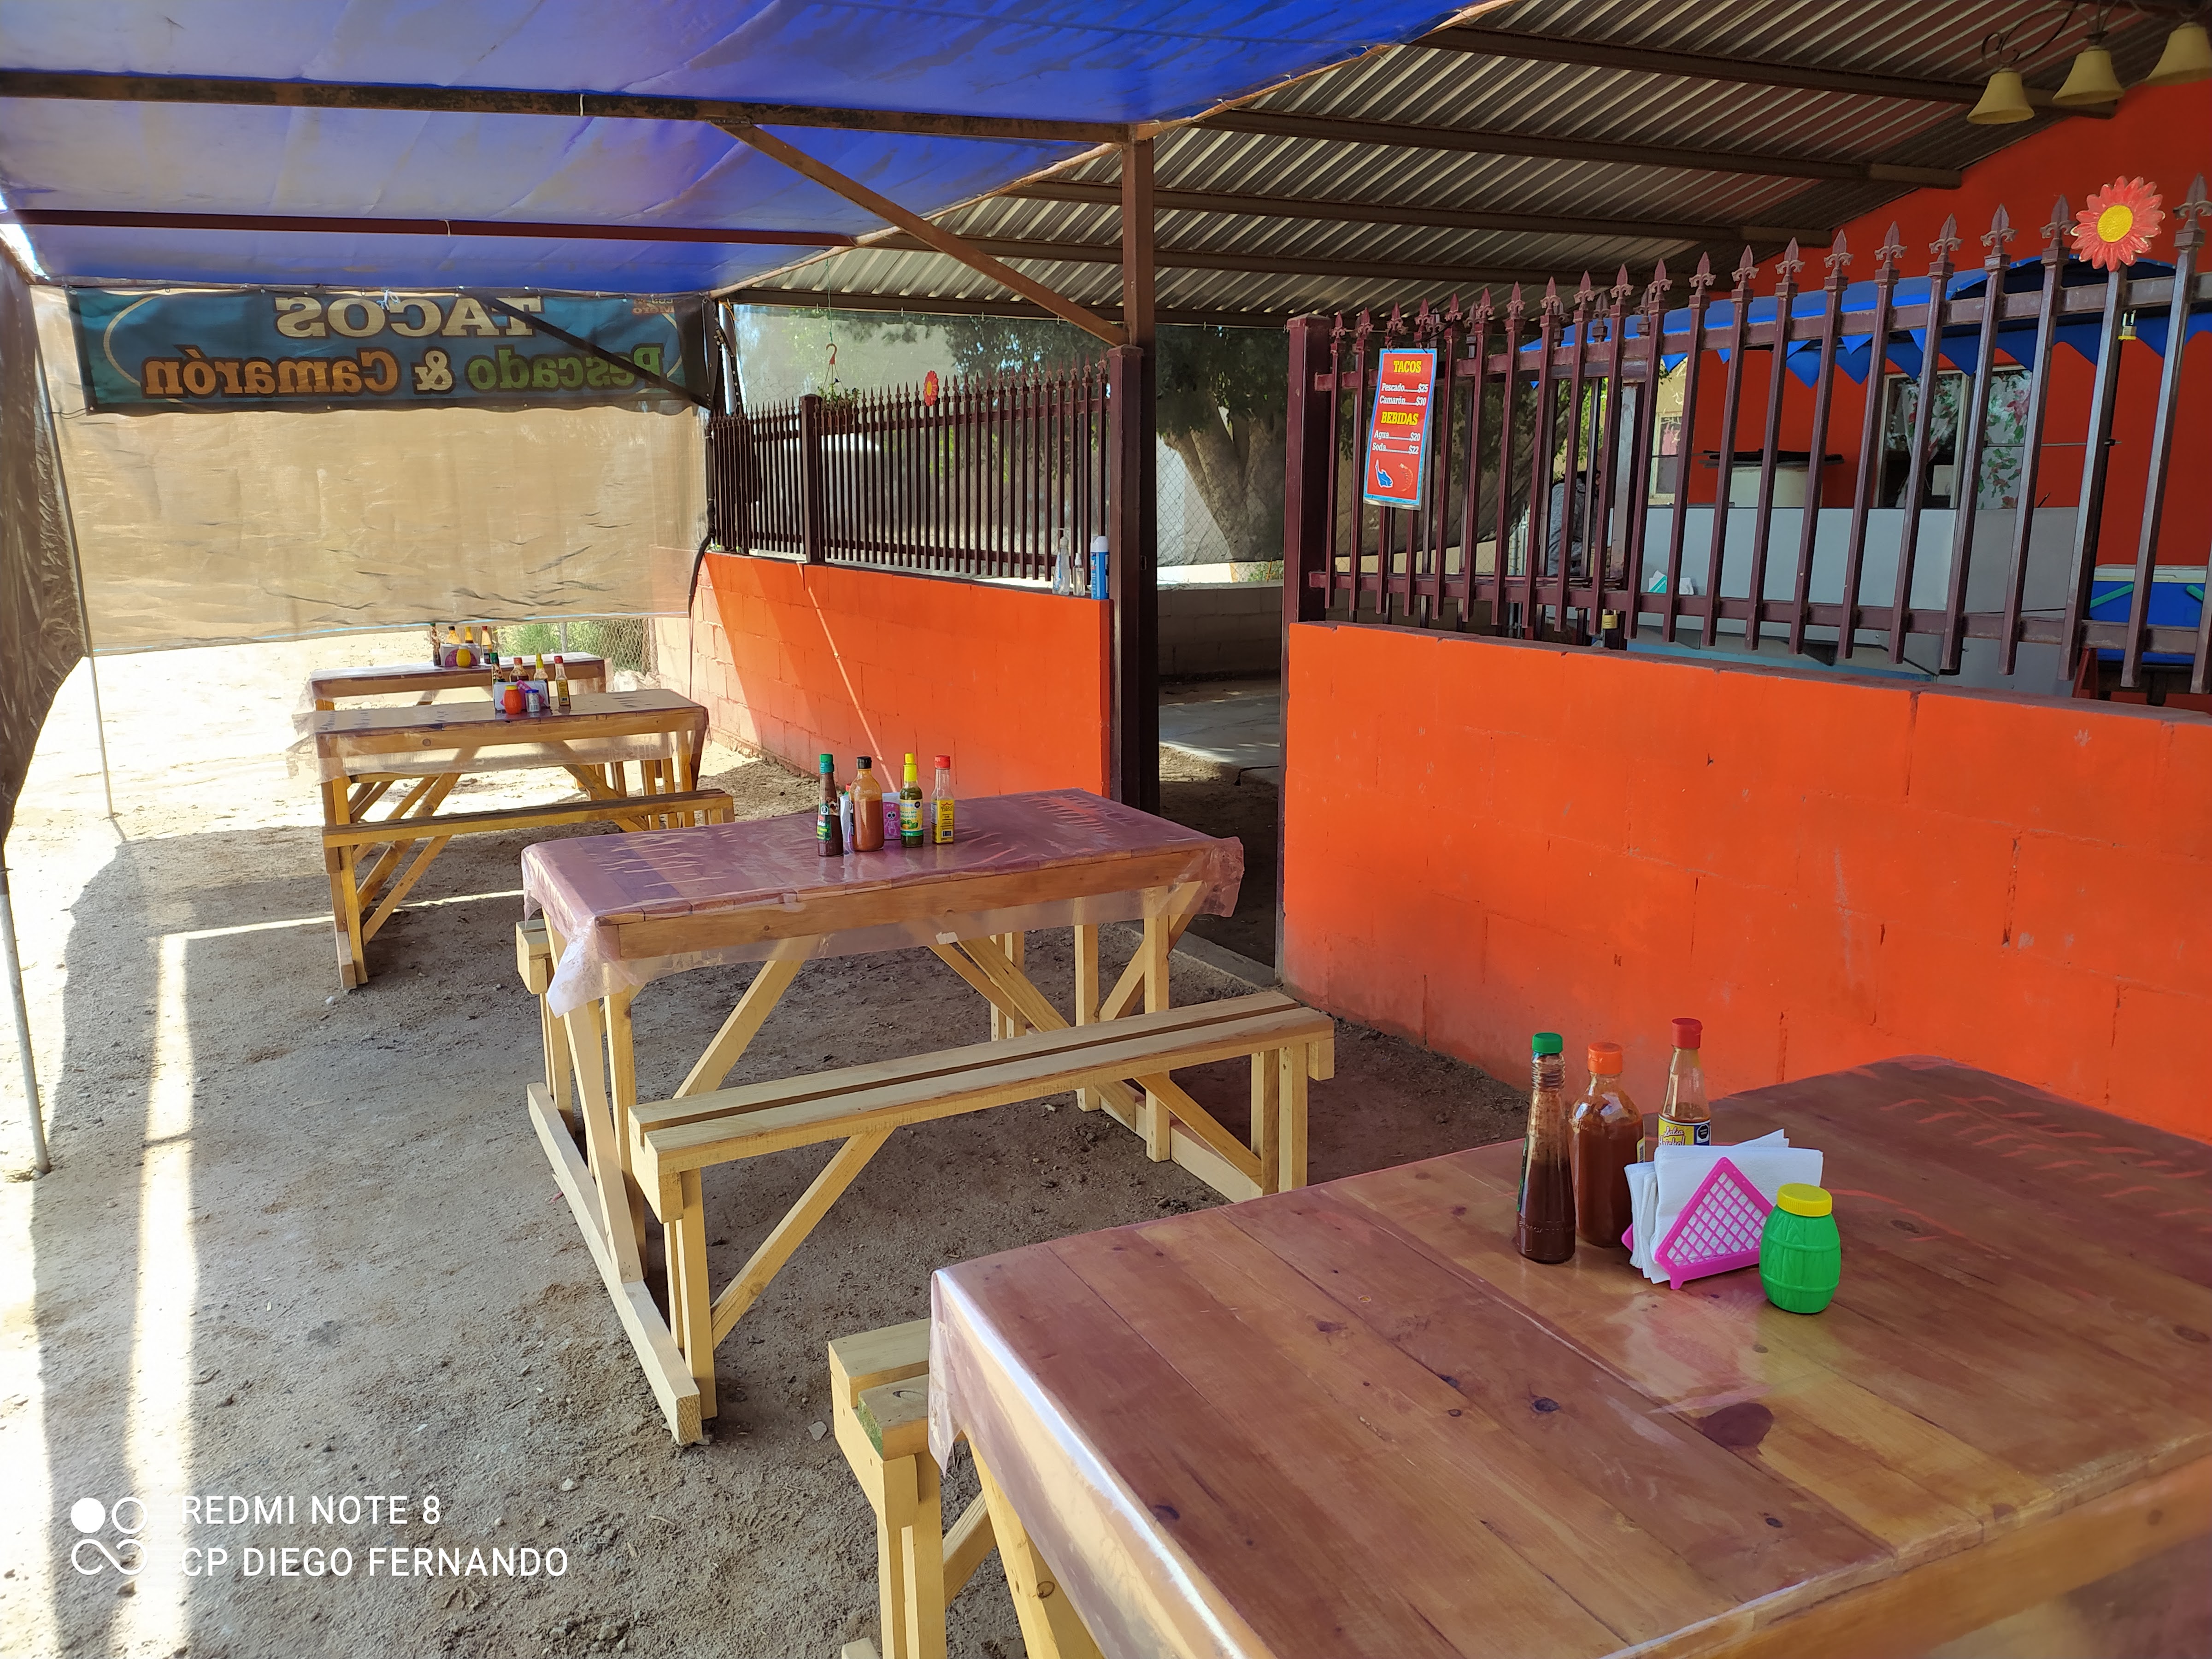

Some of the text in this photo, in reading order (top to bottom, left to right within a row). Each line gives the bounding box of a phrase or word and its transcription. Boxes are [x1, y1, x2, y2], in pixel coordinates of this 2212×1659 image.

[1393, 360, 1422, 373] TACOS
[1381, 382, 1429, 393] Pescado $25
[1416, 396, 1427, 406] $30
[1380, 411, 1419, 425] BEBIDAS
[1374, 430, 1421, 441] Agua $20
[1372, 442, 1419, 455] Soda $22
[1663, 1125, 1685, 1137] Salsa
